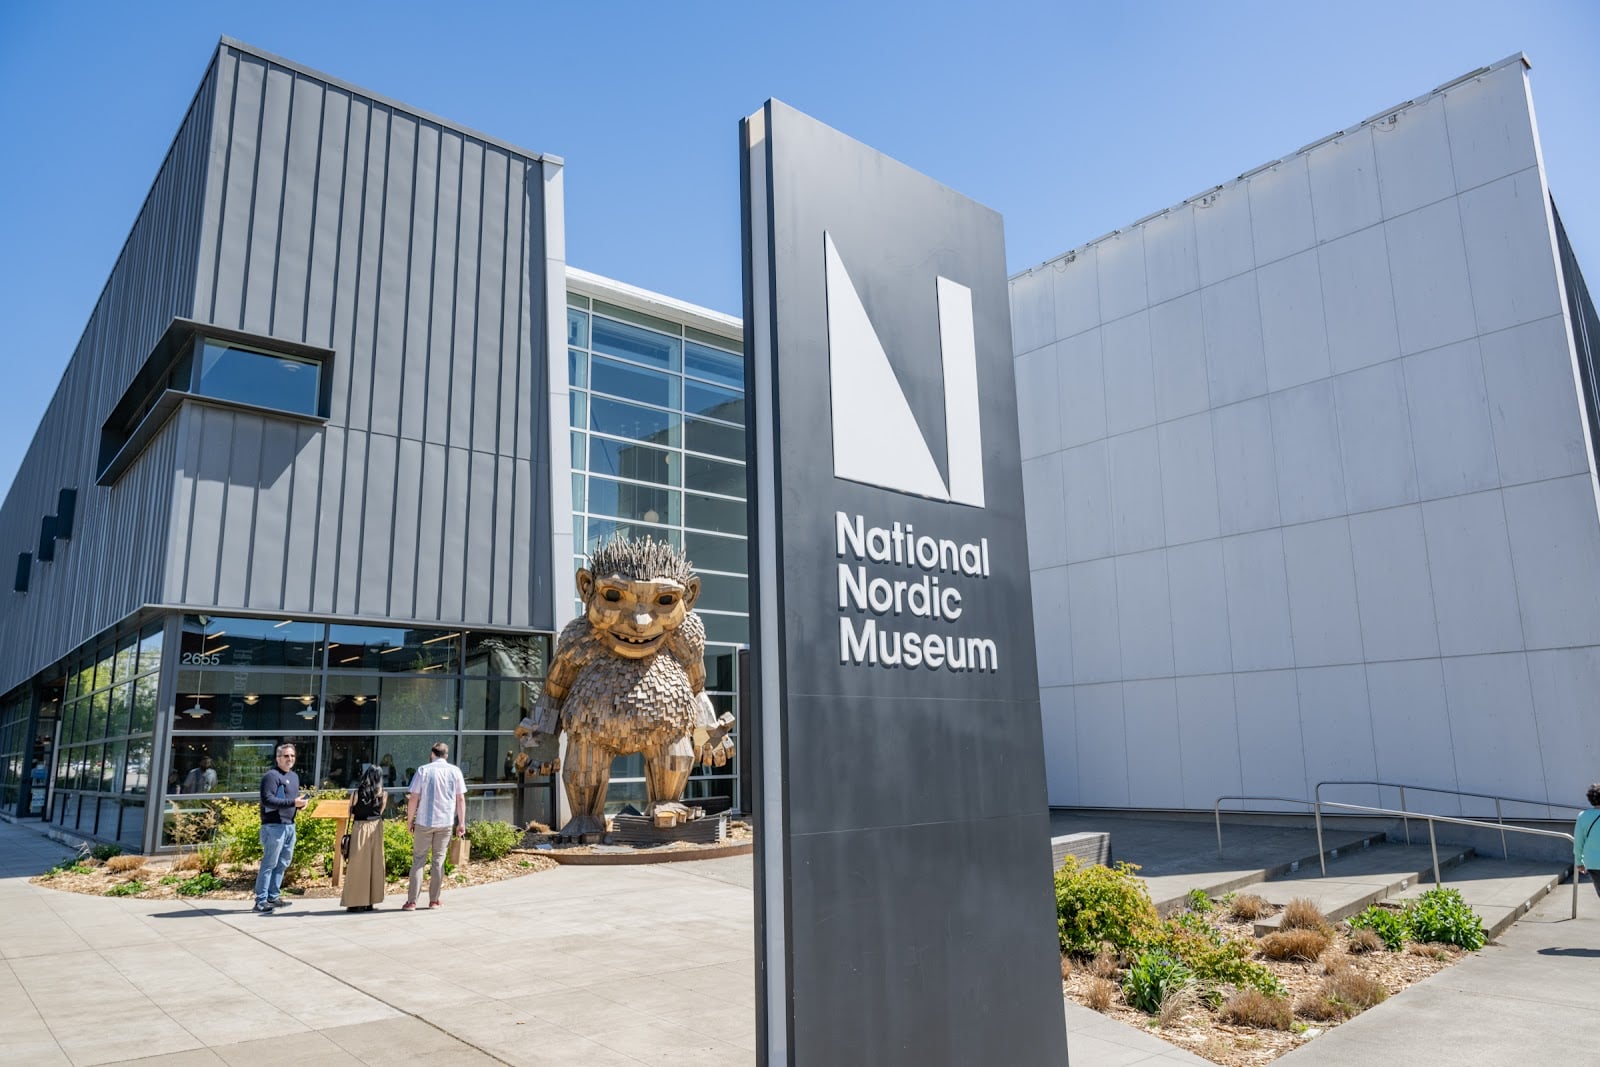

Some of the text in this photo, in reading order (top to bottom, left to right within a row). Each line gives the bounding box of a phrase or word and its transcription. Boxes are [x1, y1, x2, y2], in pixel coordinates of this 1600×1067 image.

[824, 230, 985, 508] N
[835, 511, 990, 577] National
[838, 563, 962, 620] Nordic
[183, 652, 220, 665] 2655
[839, 617, 998, 670] Museum
